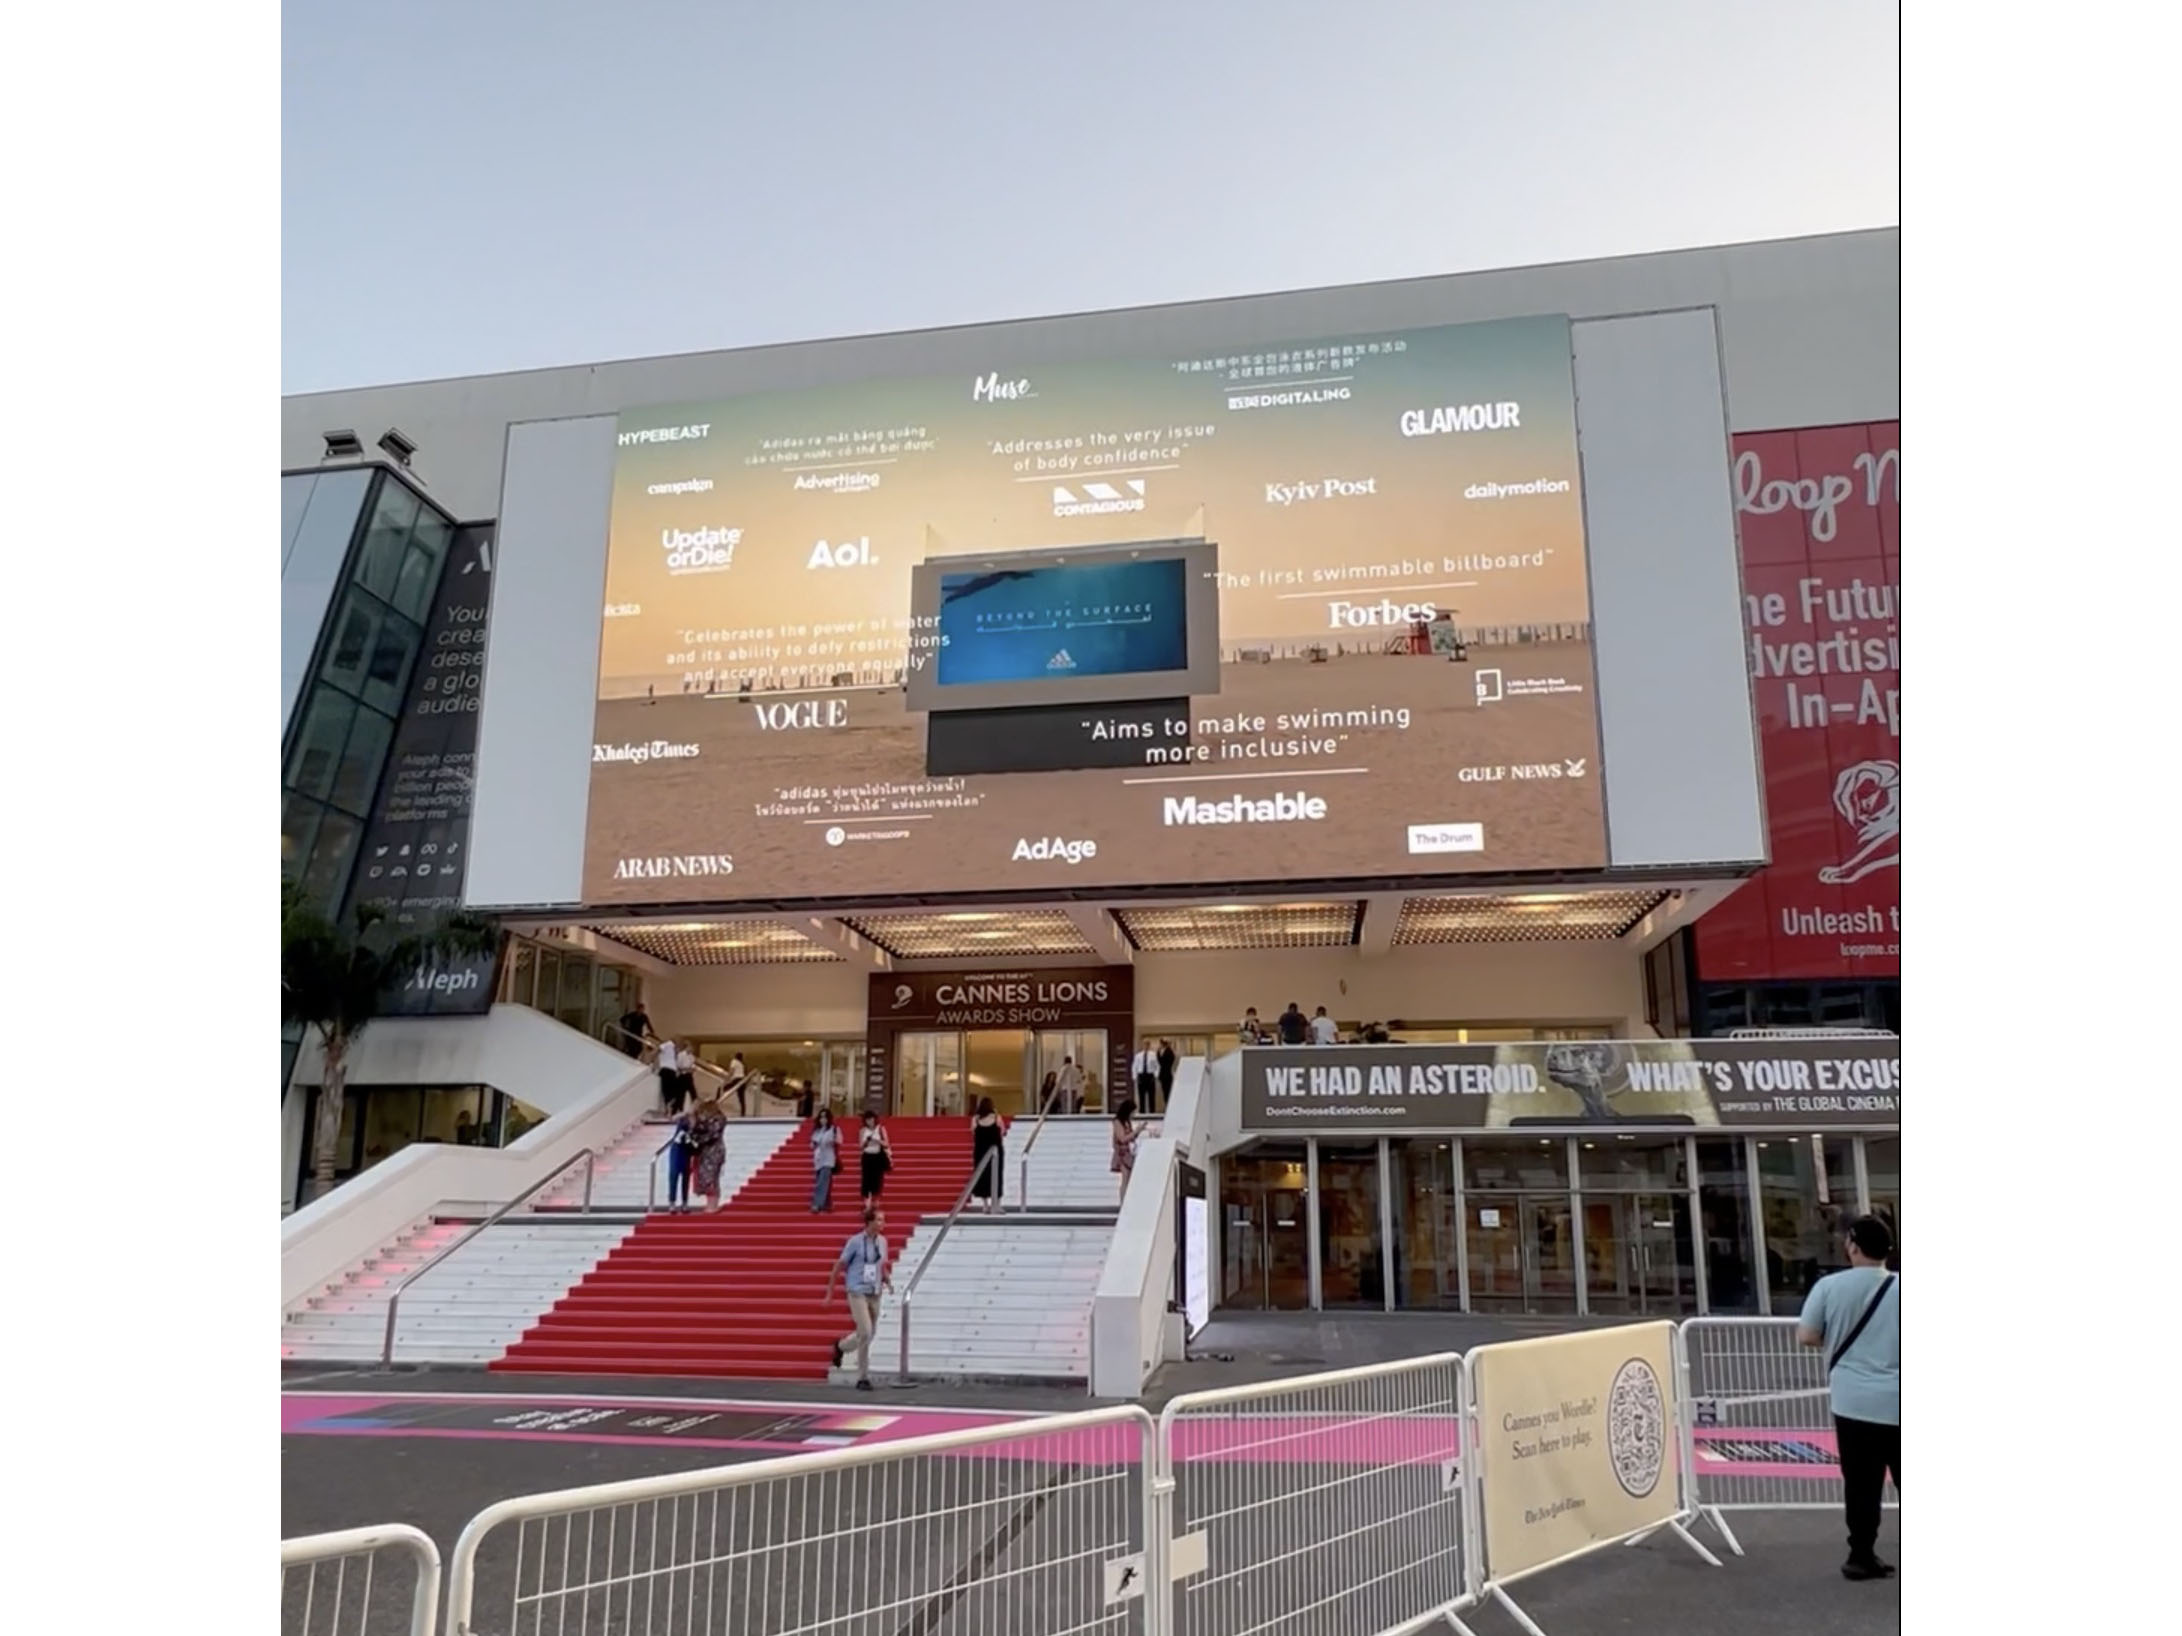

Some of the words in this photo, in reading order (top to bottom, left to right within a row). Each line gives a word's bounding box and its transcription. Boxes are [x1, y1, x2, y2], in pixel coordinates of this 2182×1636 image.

[973, 372, 1031, 402] Muse
[1401, 402, 1520, 437] GLAMOUR
[618, 424, 710, 446] HYPEBEAST
[986, 435, 1084, 455] "Addresses
[1090, 432, 1118, 445] the
[1124, 427, 1161, 446] very
[1168, 423, 1216, 439] issue
[1014, 459, 1030, 472] of
[1037, 454, 1078, 471] body
[1084, 442, 1189, 466] confidence"
[794, 471, 880, 490] Advertising
[1266, 481, 1321, 507] Kyiv
[1324, 477, 1377, 497] Post
[1465, 478, 1569, 500] dailymotion
[1053, 499, 1145, 517] CONTAGIOUS
[662, 525, 742, 553] Update
[807, 537, 880, 569] Aol.
[667, 544, 734, 568] orDie!
[1203, 571, 1250, 589] "The
[1258, 568, 1303, 586] first
[1312, 559, 1435, 583] swimmable
[1443, 548, 1554, 574] billboard"
[1328, 600, 1436, 629] Forbes
[676, 624, 775, 645] "Celebrates
[780, 622, 807, 638] the
[813, 620, 863, 639] power
[667, 651, 695, 666] and
[701, 648, 722, 663] its
[728, 645, 780, 664] ability
[787, 643, 802, 657] to
[808, 640, 844, 660] defy
[849, 633, 951, 653] restrictions
[424, 675, 437, 692] a
[683, 667, 713, 683] and
[719, 664, 774, 685] accept
[780, 660, 855, 679] everyone
[755, 699, 848, 730] VOGUE
[1081, 720, 1154, 741] "Aims
[1165, 718, 1189, 736] to
[1199, 713, 1266, 735] make
[1276, 706, 1411, 731] swimming
[593, 743, 649, 765] Khaleej
[651, 740, 700, 759] Times
[1146, 743, 1210, 764] more
[1220, 733, 1349, 759] inclusive"
[1458, 764, 1505, 783] GULF
[1511, 762, 1562, 780] NEWS
[1163, 791, 1327, 826] Mashable
[1012, 837, 1097, 864] AdAge
[1415, 833, 1438, 845] The
[1440, 832, 1473, 844] Drum
[614, 857, 670, 880] ARAB
[673, 854, 733, 876] NEWS
[1782, 904, 1884, 935] Unleash
[404, 964, 479, 995] Aleph
[935, 984, 1030, 1006] CANNES
[1037, 981, 1109, 1003] LIONS
[936, 1010, 1005, 1025] AWARDS
[1009, 1008, 1061, 1023] SHOW
[1266, 1067, 1304, 1097] WE
[1309, 1066, 1362, 1097] HAD
[1369, 1065, 1402, 1095] AN
[1409, 1063, 1547, 1096] ASTEROID.
[1627, 1061, 1733, 1092] WHAT'S
[1736, 1060, 1812, 1091] YOUR
[1266, 1105, 1406, 1117] DontChooseExtinction.com
[1773, 1097, 1798, 1112] THE
[1799, 1097, 1846, 1111] GLOBAL
[1847, 1096, 1896, 1111] CINEMA
[1503, 1412, 1541, 1433] Cannes
[1543, 1410, 1560, 1428] you
[1561, 1397, 1598, 1420] Wordle?
[1512, 1440, 1538, 1460] Scan
[1539, 1436, 1560, 1455] here
[1561, 1434, 1571, 1448] to
[1572, 1427, 1593, 1450] play.
